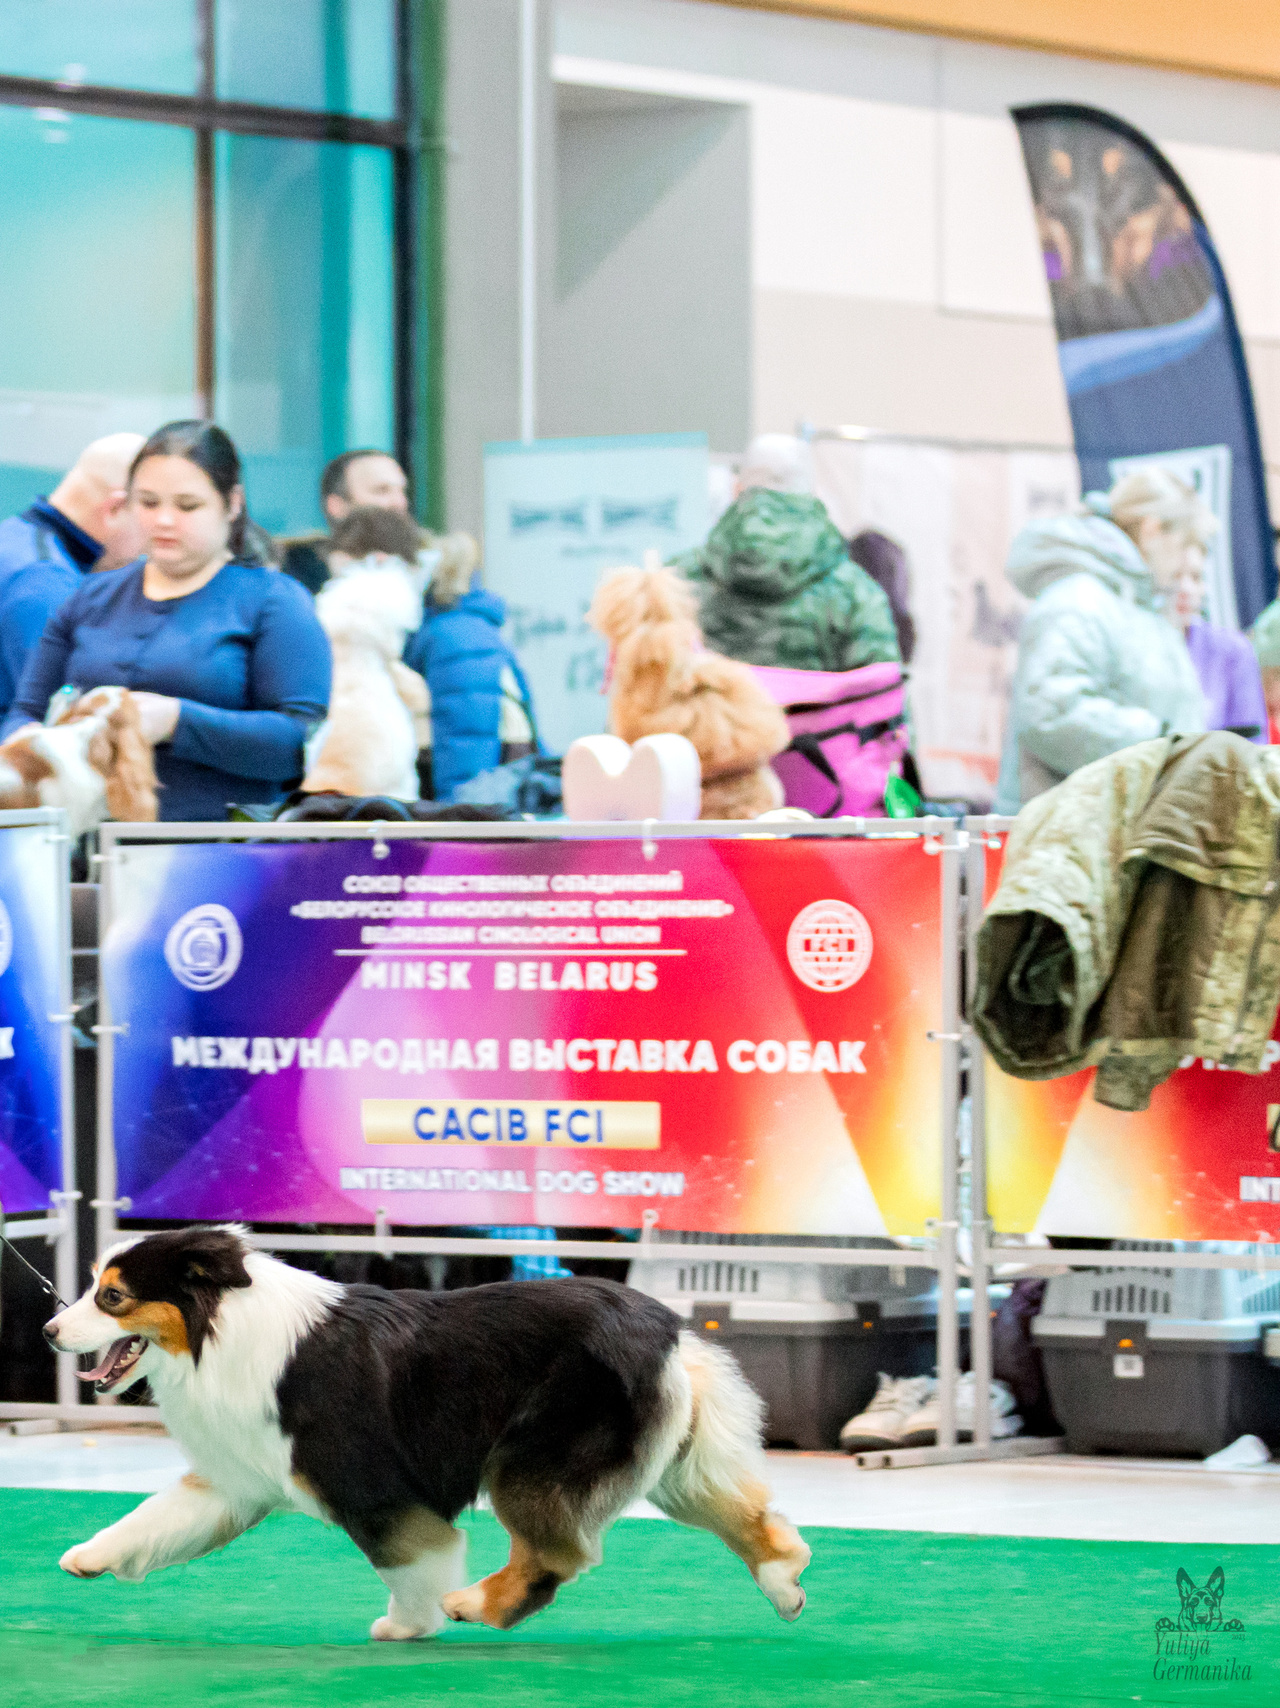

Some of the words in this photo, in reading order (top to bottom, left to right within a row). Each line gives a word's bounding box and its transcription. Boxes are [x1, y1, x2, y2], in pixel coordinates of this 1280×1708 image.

[601, 926, 661, 944] UNION
[361, 961, 471, 990] MINSK
[494, 961, 658, 991] BELARUS
[171, 1036, 499, 1074] МЕЖДУНАРОДНАЯ
[508, 1038, 719, 1073] ВЫСТАВКА
[726, 1039, 867, 1074] СОБАК
[412, 1107, 529, 1143] CACIB
[544, 1108, 604, 1143] FCI
[339, 1167, 532, 1193] INTERNATIONAL
[535, 1170, 598, 1195] DOG
[602, 1170, 685, 1197] SHOW
